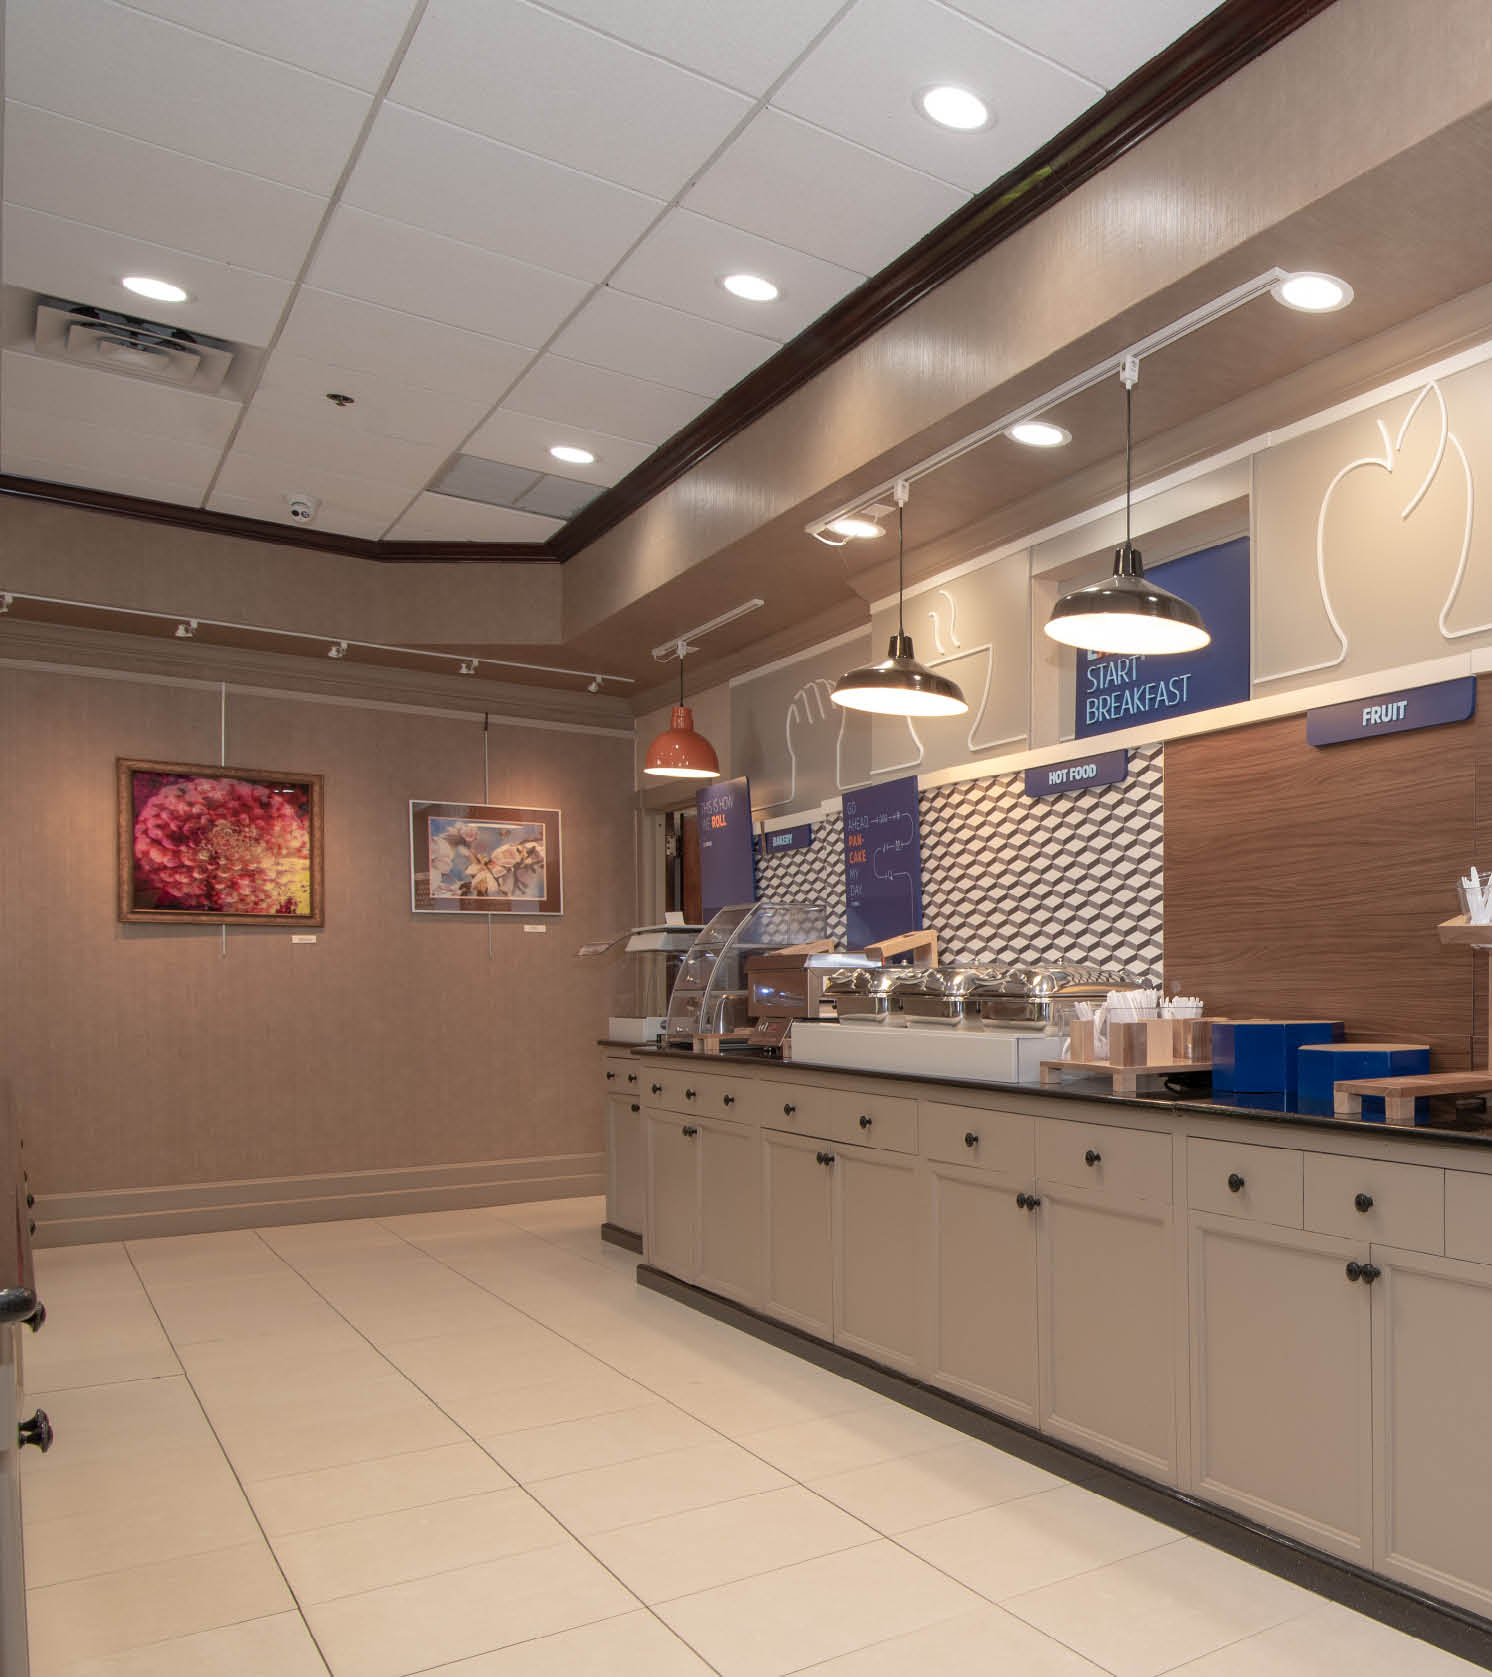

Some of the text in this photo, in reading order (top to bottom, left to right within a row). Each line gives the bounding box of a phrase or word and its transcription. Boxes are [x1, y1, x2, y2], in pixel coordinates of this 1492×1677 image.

[1087, 655, 1140, 693] START
[1086, 673, 1192, 725] BREAKFAST
[1362, 700, 1408, 727] FRUIT
[1048, 764, 1097, 785] HOT FOOD
[711, 814, 728, 828] ROLL
[772, 833, 793, 847] BAKERY
